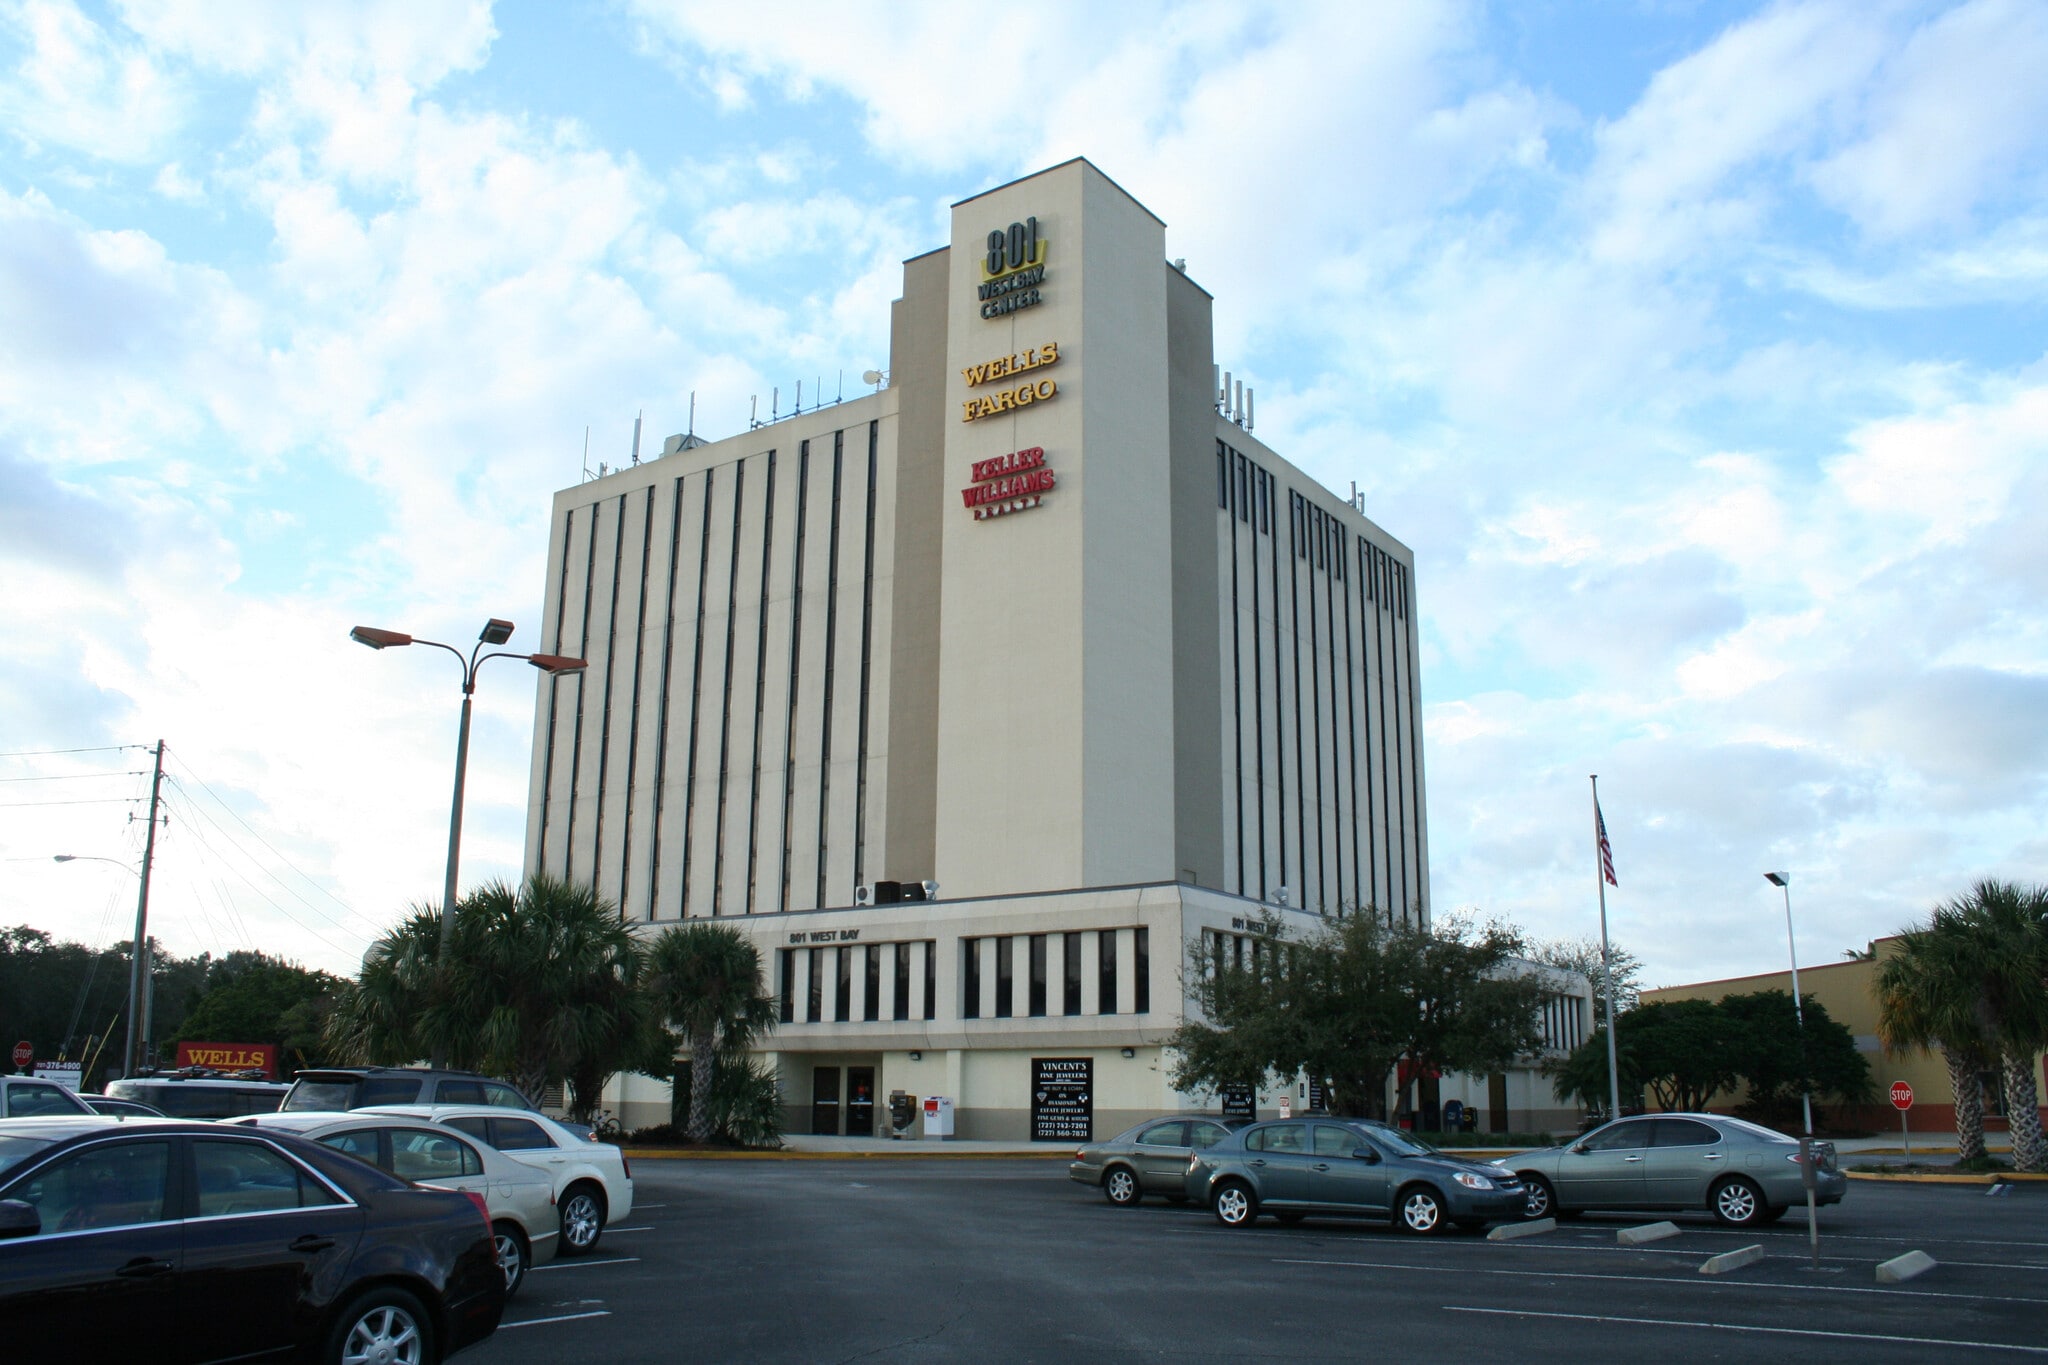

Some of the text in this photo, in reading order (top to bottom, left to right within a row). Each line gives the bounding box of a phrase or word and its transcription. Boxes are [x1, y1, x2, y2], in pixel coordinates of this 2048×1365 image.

[986, 216, 1037, 276] 801
[977, 265, 1044, 301] WEST BAY
[980, 288, 1042, 320] CENTER
[961, 342, 1058, 388] WELLS
[962, 378, 1057, 423] FARGO
[971, 446, 1045, 483] KELLER
[961, 469, 1056, 508] WILLIAMS
[974, 495, 1041, 521] REALTY
[789, 928, 860, 944] 801 WEST BAY
[14, 1048, 32, 1060] STOP
[187, 1049, 265, 1067] WELLS
[1042, 1062, 1087, 1071] VINCENT'S
[1891, 1090, 1911, 1101] STOP
